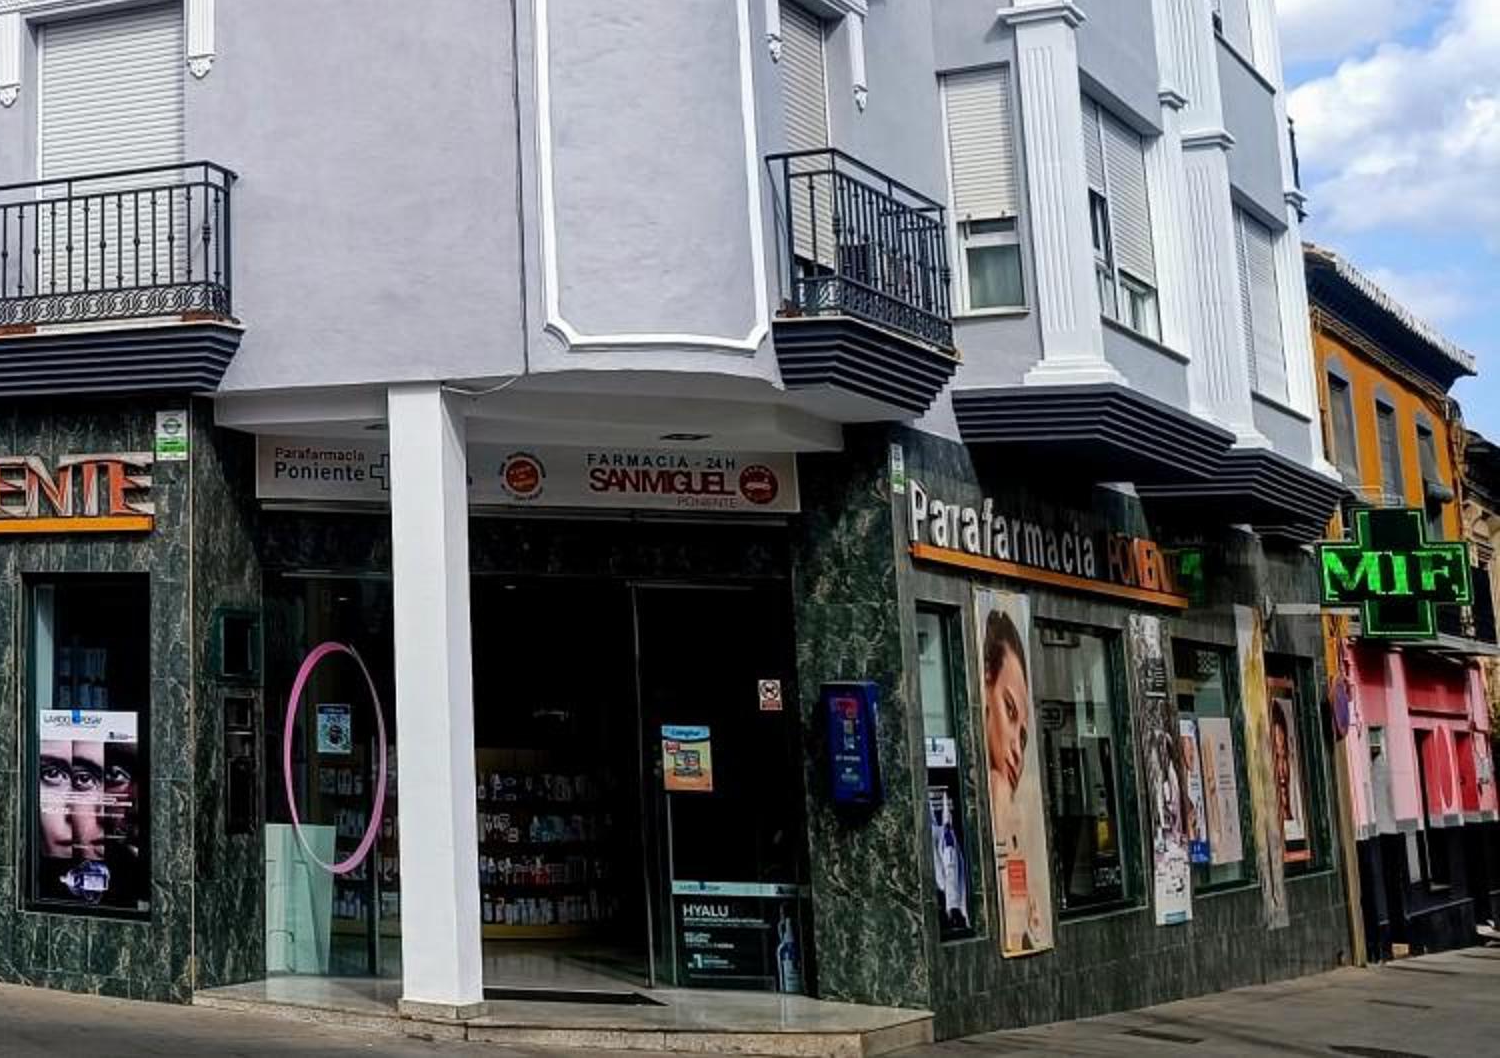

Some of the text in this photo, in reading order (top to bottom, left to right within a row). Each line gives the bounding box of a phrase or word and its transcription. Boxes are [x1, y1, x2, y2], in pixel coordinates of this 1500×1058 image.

[275, 447, 365, 462] Parafarmacia
[587, 453, 689, 469] FARMACIA
[274, 461, 365, 482] Poniente
[908, 478, 1096, 579] Parafarmacia
[682, 904, 729, 917] HYALU
